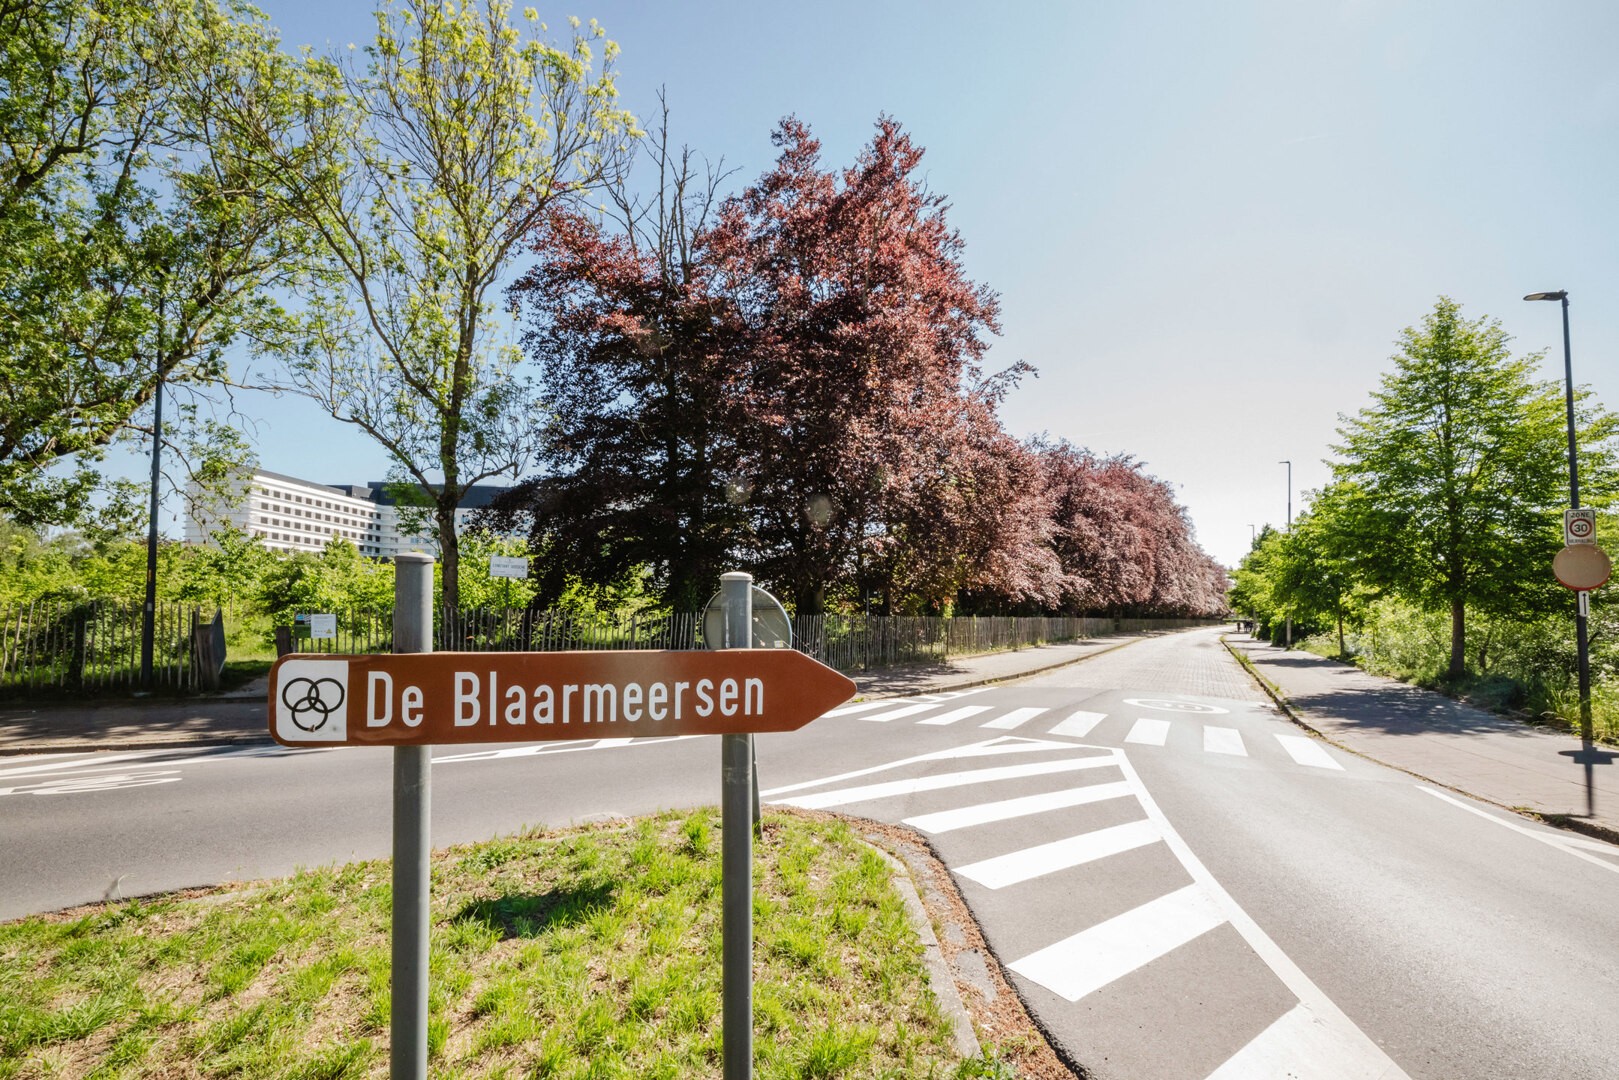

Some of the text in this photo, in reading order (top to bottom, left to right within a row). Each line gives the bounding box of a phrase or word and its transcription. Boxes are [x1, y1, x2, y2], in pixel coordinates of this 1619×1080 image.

[1574, 524, 1588, 532] 30
[366, 671, 764, 728] De Blaarmeersen
